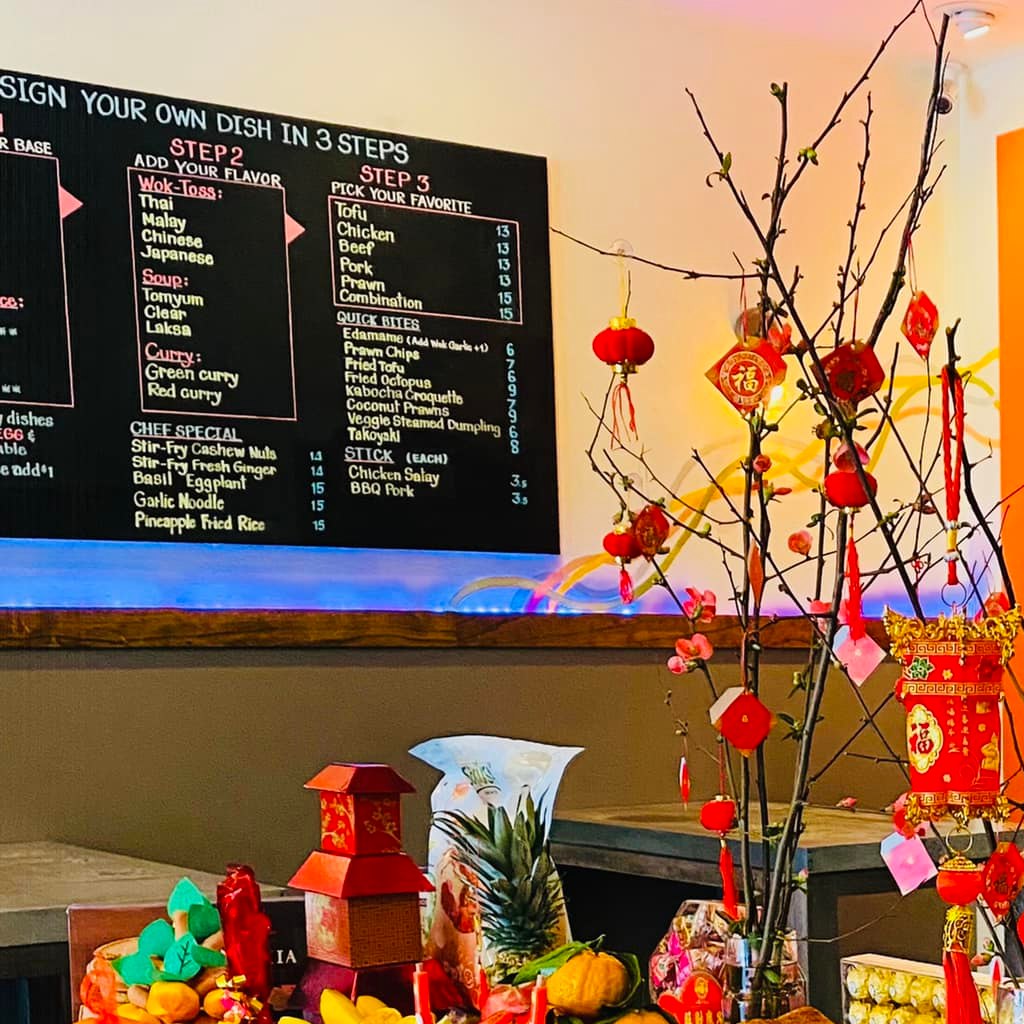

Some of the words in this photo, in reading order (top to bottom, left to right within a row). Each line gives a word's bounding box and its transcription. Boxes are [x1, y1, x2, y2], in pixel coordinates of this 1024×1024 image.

[0, 75, 66, 109] SIGN
[81, 89, 147, 123] YOUR
[156, 103, 206, 131] OWN
[217, 113, 272, 141] DISH
[281, 122, 308, 147] IN
[316, 128, 332, 150] 3
[337, 133, 410, 164] STEPS
[14, 138, 53, 155] BASE
[169, 138, 227, 164] STEP
[230, 146, 244, 167] 2
[134, 153, 169, 169] ADD
[175, 160, 218, 179] YOUR
[224, 168, 282, 188] FLAVOR
[359, 165, 411, 188] STEP
[416, 175, 431, 193] 3
[138, 194, 174, 211] Thai
[331, 181, 364, 198] PICK
[370, 187, 406, 205] YOUR
[411, 194, 473, 214] FAVORITE
[334, 200, 367, 222] Tofu
[142, 212, 187, 233] Malay
[336, 221, 395, 243] Chicken
[496, 225, 511, 238] 13
[141, 229, 203, 249] Chinese
[338, 240, 375, 256] Beef
[497, 242, 510, 254] 13
[140, 245, 214, 266] Japanese
[497, 258, 511, 271] 13
[339, 257, 374, 276] Pork
[341, 275, 386, 292] Prawn
[498, 274, 512, 287] 13
[142, 287, 204, 308] Tomyum
[339, 289, 423, 311] Combination
[498, 292, 513, 305] 15
[143, 305, 187, 320] Clear
[336, 311, 377, 327] QUICK
[382, 316, 420, 331] BITES
[499, 308, 514, 320] 15
[146, 321, 192, 337] Laksa
[343, 327, 403, 344] Edamame
[344, 341, 383, 357] Prawn
[386, 345, 420, 363] Chips
[506, 343, 515, 356] 6
[345, 357, 377, 372] Fried
[378, 360, 405, 374] Tofu
[144, 363, 195, 381] Green
[199, 370, 239, 389] curry
[345, 371, 377, 385] Fried
[381, 374, 432, 390] Octopus
[507, 371, 516, 383] 6
[731, 365, 760, 393] 福
[147, 383, 176, 399] Red
[180, 387, 222, 406] curry
[345, 385, 403, 399] Kabocha
[405, 389, 463, 406] Croquette
[507, 384, 517, 397] 9
[346, 399, 400, 413] Coconut
[403, 402, 449, 417] Prawns
[508, 411, 517, 423] 9
[7, 410, 54, 427] dishes
[347, 412, 391, 430] Veggie
[393, 415, 445, 430] Steamed
[448, 419, 501, 438] Dumpling
[130, 420, 172, 436] CHEF
[176, 424, 243, 442] SPECIAL
[347, 427, 400, 446] Takoyaki
[509, 425, 518, 438] 6
[131, 439, 188, 459] Stir-Fry
[191, 442, 245, 458] Cashew
[344, 446, 393, 463] STICK
[510, 439, 519, 454] 8
[132, 456, 188, 475] Stir-Fry
[192, 459, 230, 473] Fresh
[233, 461, 277, 480] Ginger
[348, 465, 401, 481] Chicken
[133, 471, 172, 486] Basil
[186, 474, 246, 493] Eggplant
[311, 482, 325, 495] 15
[350, 481, 381, 496] BBQ
[385, 483, 415, 497] Pork
[133, 491, 175, 508] Garlic
[178, 492, 224, 510] Noodle
[311, 500, 325, 512] 15
[135, 511, 196, 534] Pineapple
[201, 513, 232, 530] Fried
[238, 515, 265, 531] Rice
[909, 722, 934, 755] 福
